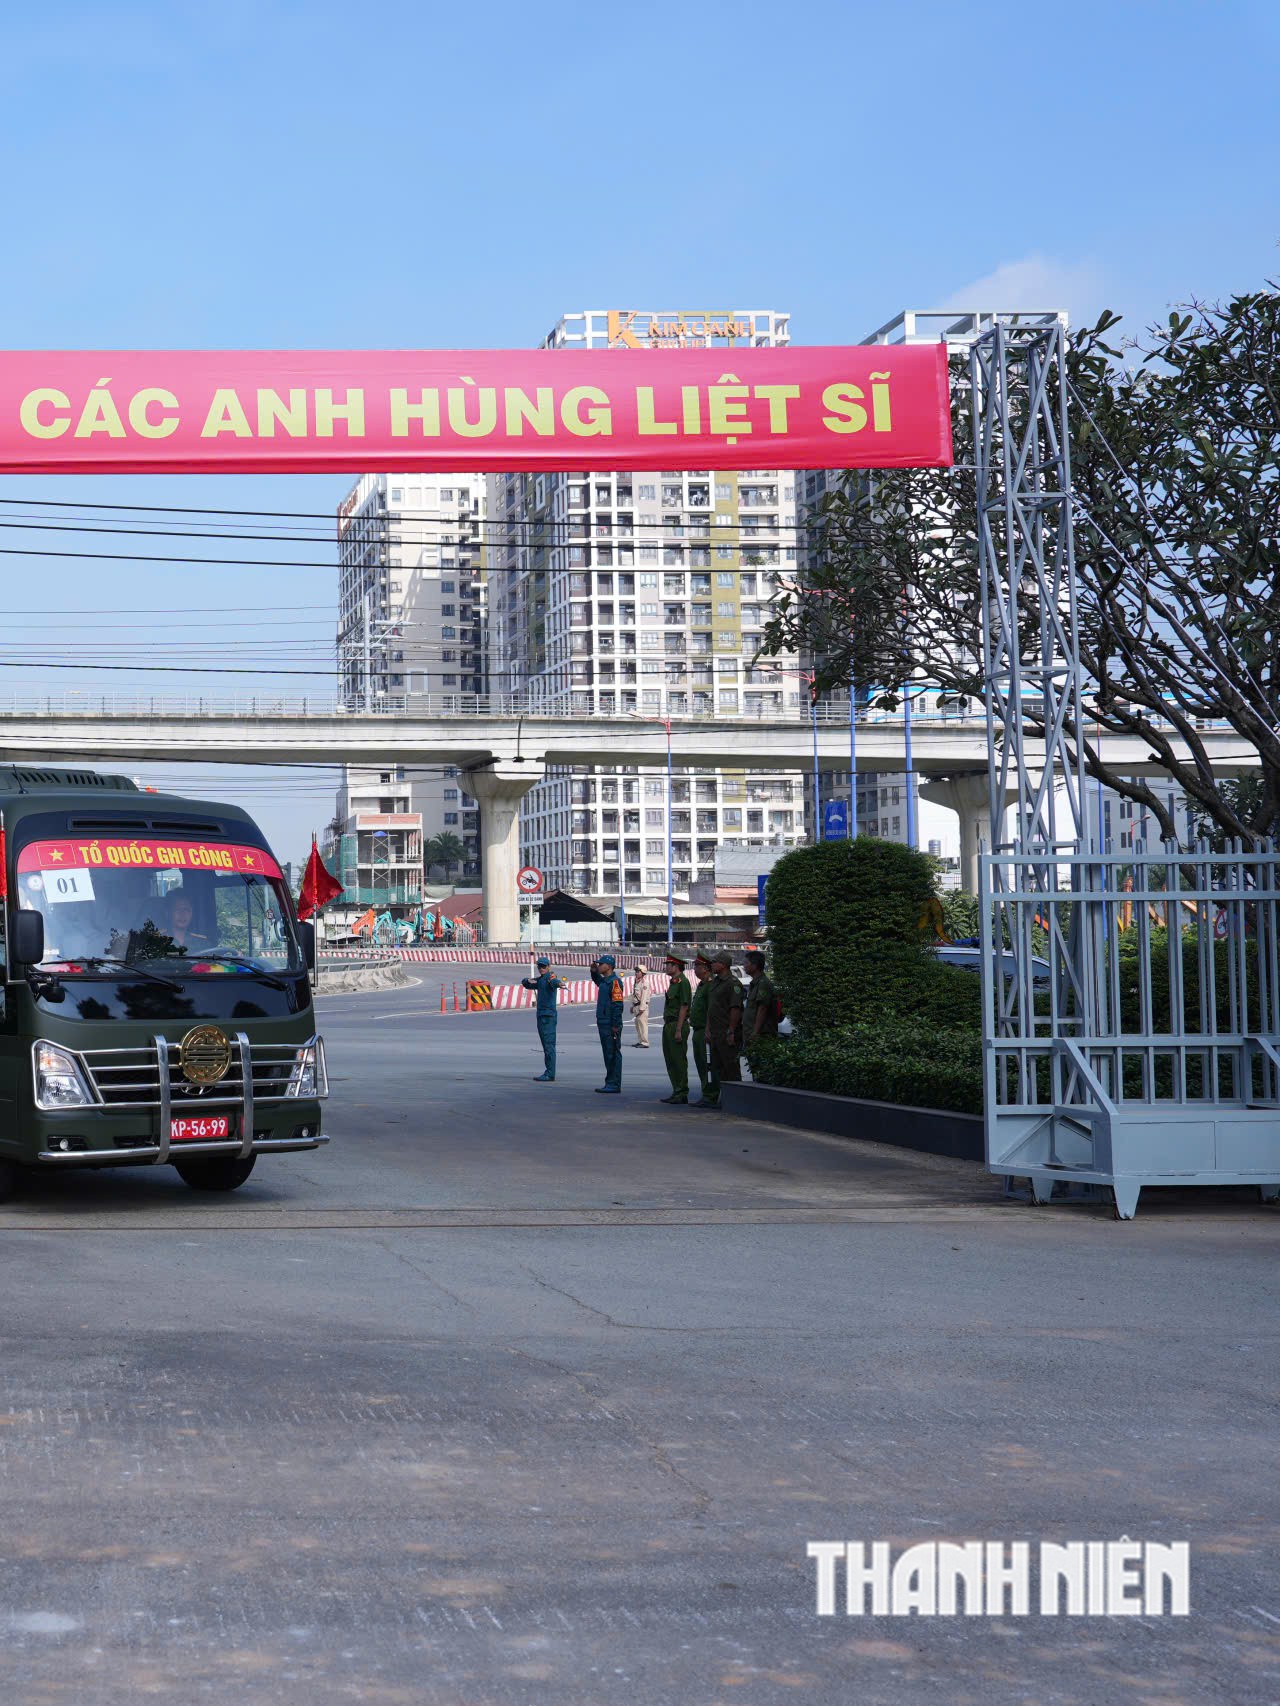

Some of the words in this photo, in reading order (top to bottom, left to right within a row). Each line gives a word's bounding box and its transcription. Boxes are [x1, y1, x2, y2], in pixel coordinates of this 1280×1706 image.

[647, 322, 687, 337] KIM
[691, 321, 755, 338] OANH
[21, 378, 178, 438] CÁC
[202, 390, 365, 436] ANH
[393, 379, 612, 437] HÙNG
[639, 377, 801, 444] LIỆT
[824, 373, 892, 434] SĨ
[80, 841, 103, 864] TỔ
[107, 842, 153, 865] QUỐC
[157, 847, 186, 865] GHI
[189, 846, 233, 868] CÔNG
[56, 877, 79, 894] 01
[171, 1119, 226, 1136] KP-56-99
